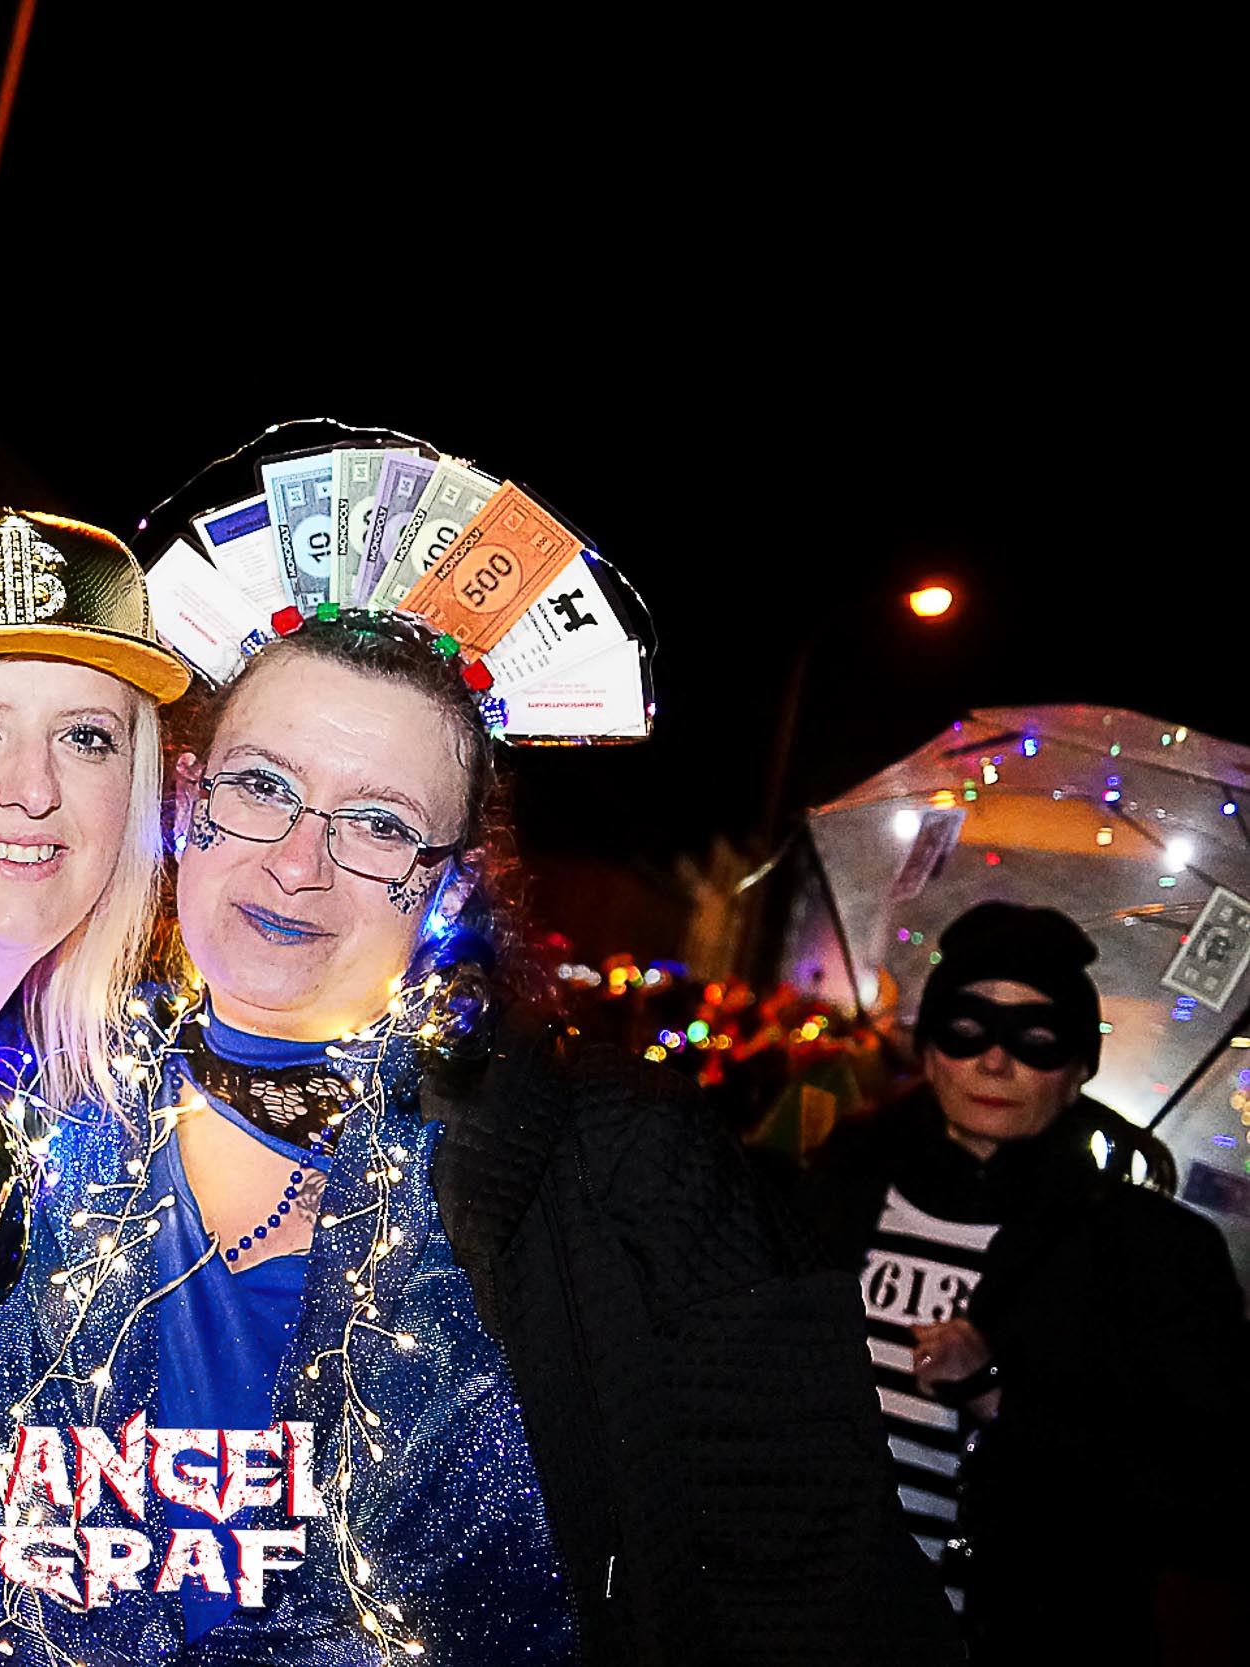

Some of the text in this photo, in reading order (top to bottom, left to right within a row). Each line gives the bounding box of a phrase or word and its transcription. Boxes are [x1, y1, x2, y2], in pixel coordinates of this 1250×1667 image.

[279, 525, 297, 577] MONOPOLY
[309, 532, 331, 563] 10
[338, 500, 348, 554] MONOPOLY
[369, 507, 388, 561] MONOPOLY
[396, 509, 427, 562] MONOPOLY
[437, 528, 481, 580] MONOPOLY
[462, 554, 512, 606] 500
